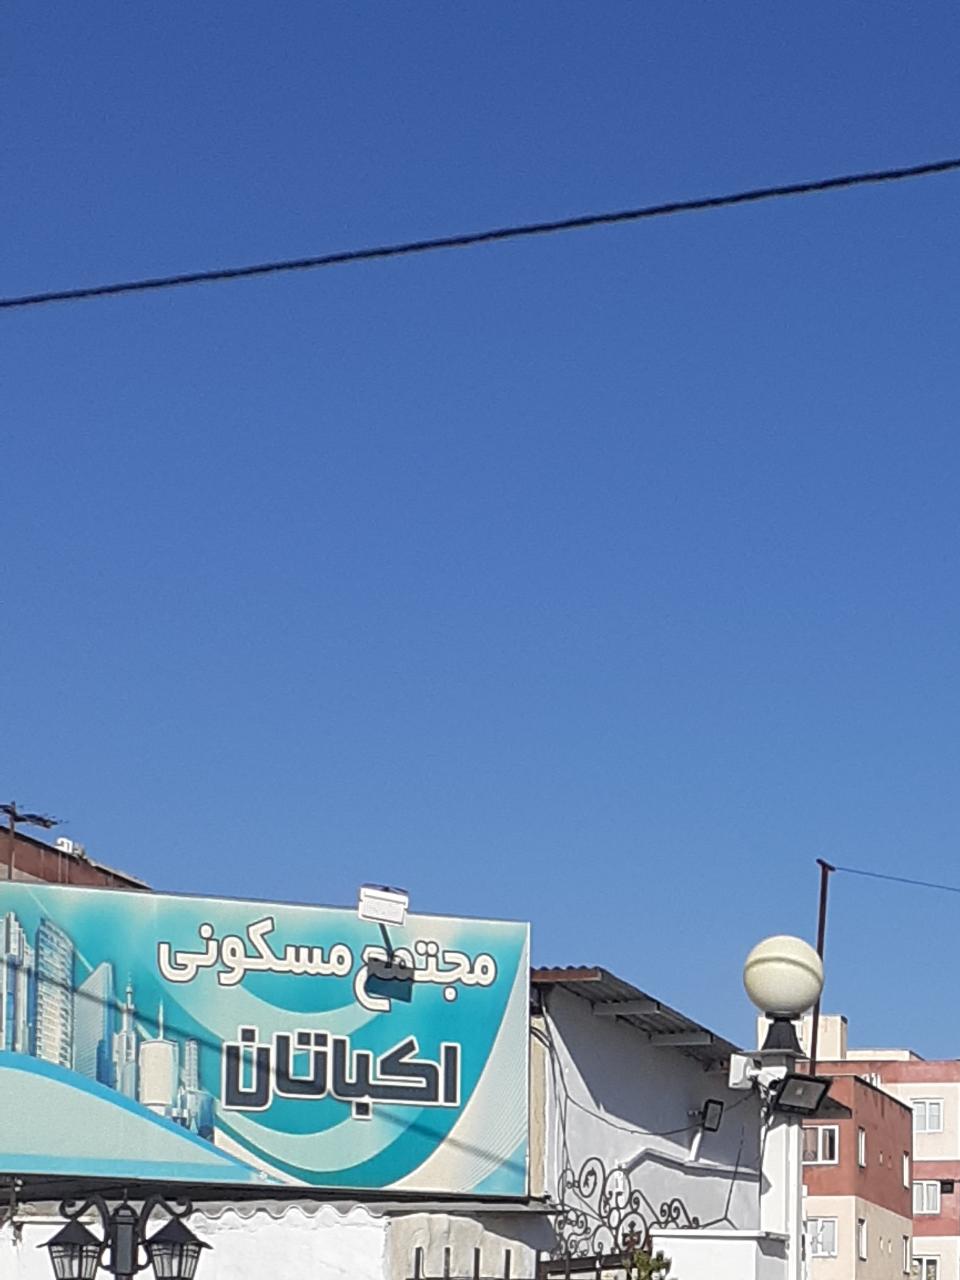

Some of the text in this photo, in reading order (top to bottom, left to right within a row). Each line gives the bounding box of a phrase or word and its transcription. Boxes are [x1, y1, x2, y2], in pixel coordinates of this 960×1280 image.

[158, 917, 497, 1012] مجتمع مسکونی
[222, 1025, 461, 1120] اکباتان
